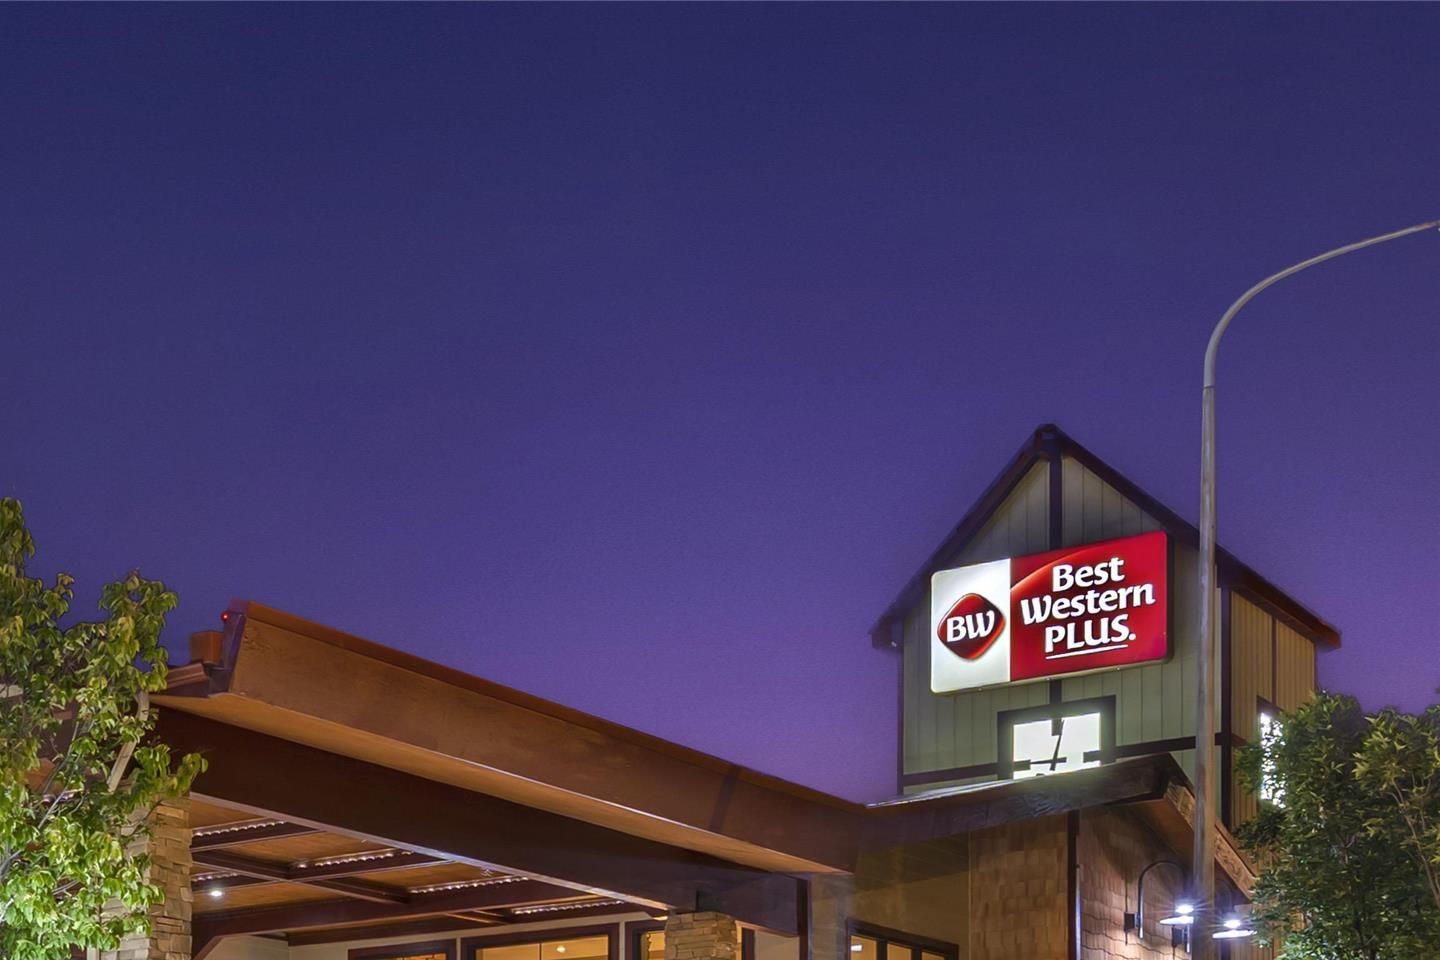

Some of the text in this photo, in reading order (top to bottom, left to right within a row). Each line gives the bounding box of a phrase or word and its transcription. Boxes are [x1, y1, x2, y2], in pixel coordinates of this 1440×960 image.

[1052, 557, 1125, 592] Best
[1020, 583, 1156, 625] Western
[946, 610, 996, 642] BW
